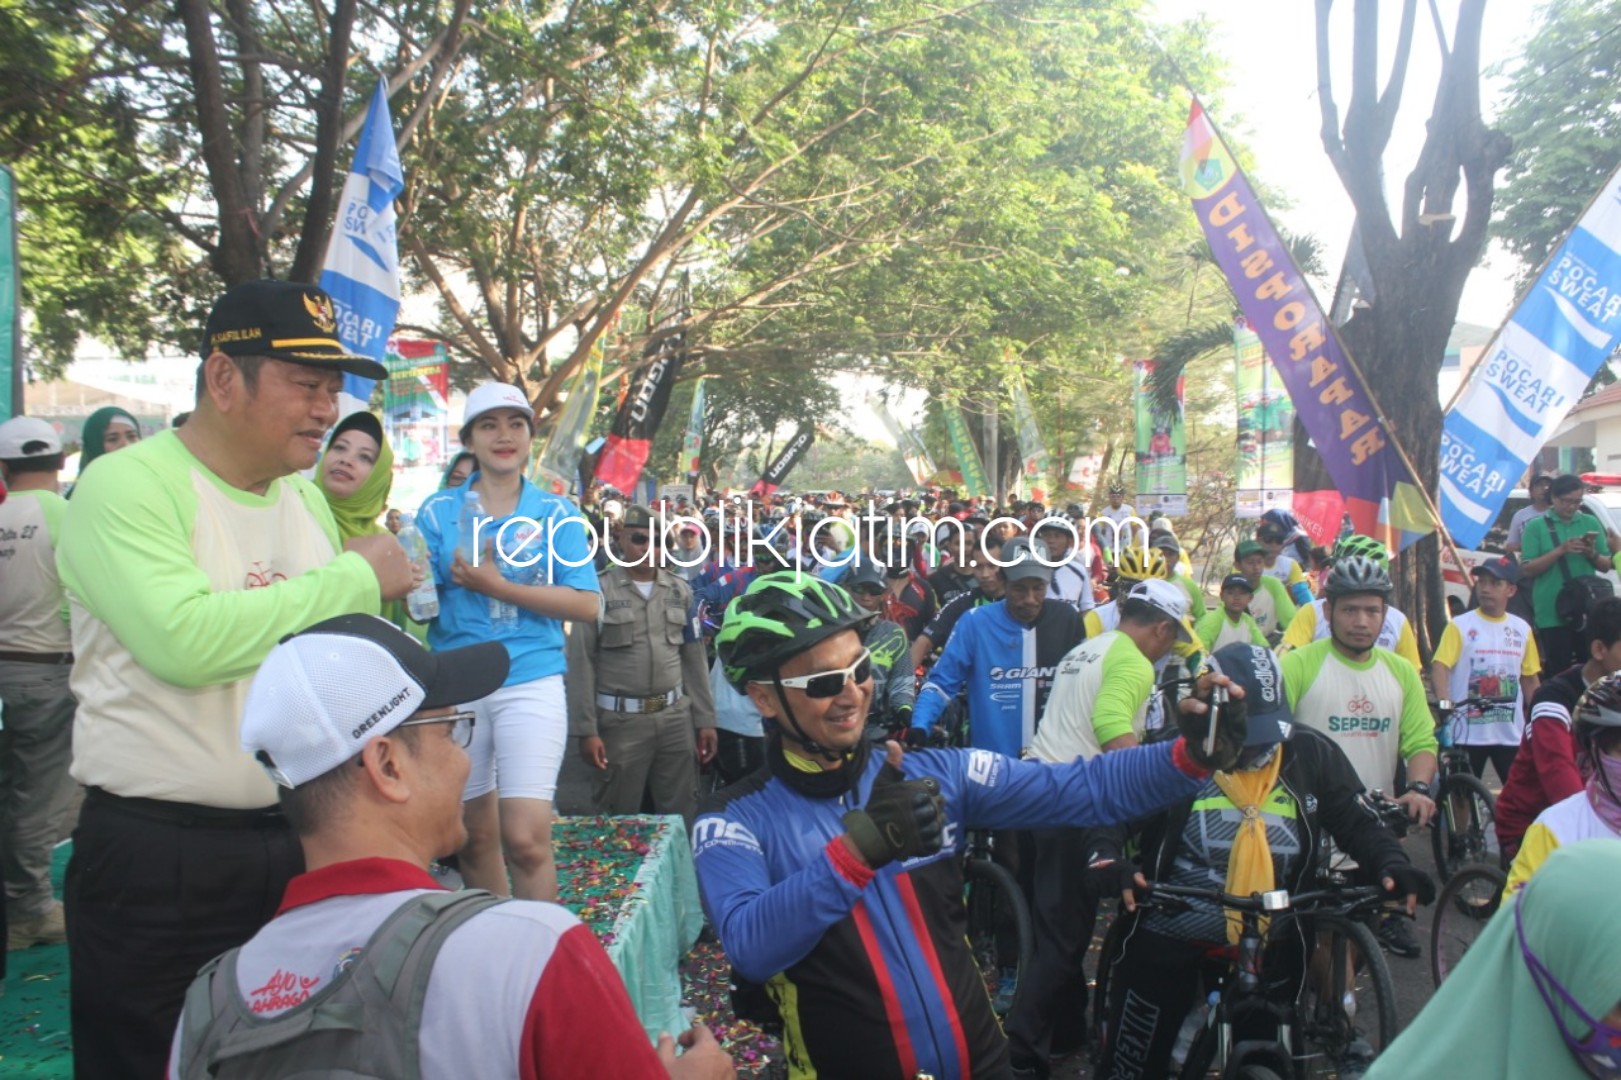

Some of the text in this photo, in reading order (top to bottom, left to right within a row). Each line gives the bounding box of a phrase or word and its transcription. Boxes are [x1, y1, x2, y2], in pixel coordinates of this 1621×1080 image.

[1548, 269, 1617, 323] SWEAT
[1556, 256, 1621, 312] POCAR
[333, 304, 382, 338] OCARI
[338, 325, 373, 347] EAT
[1486, 363, 1549, 414] SWEAT
[1494, 349, 1565, 407] POCARI
[1440, 454, 1495, 499] WEAT
[1441, 433, 1506, 492] POCARI
[1250, 645, 1275, 702] adida
[352, 687, 411, 739] GREENLIGHT
[1328, 715, 1391, 732] SEPEDA
